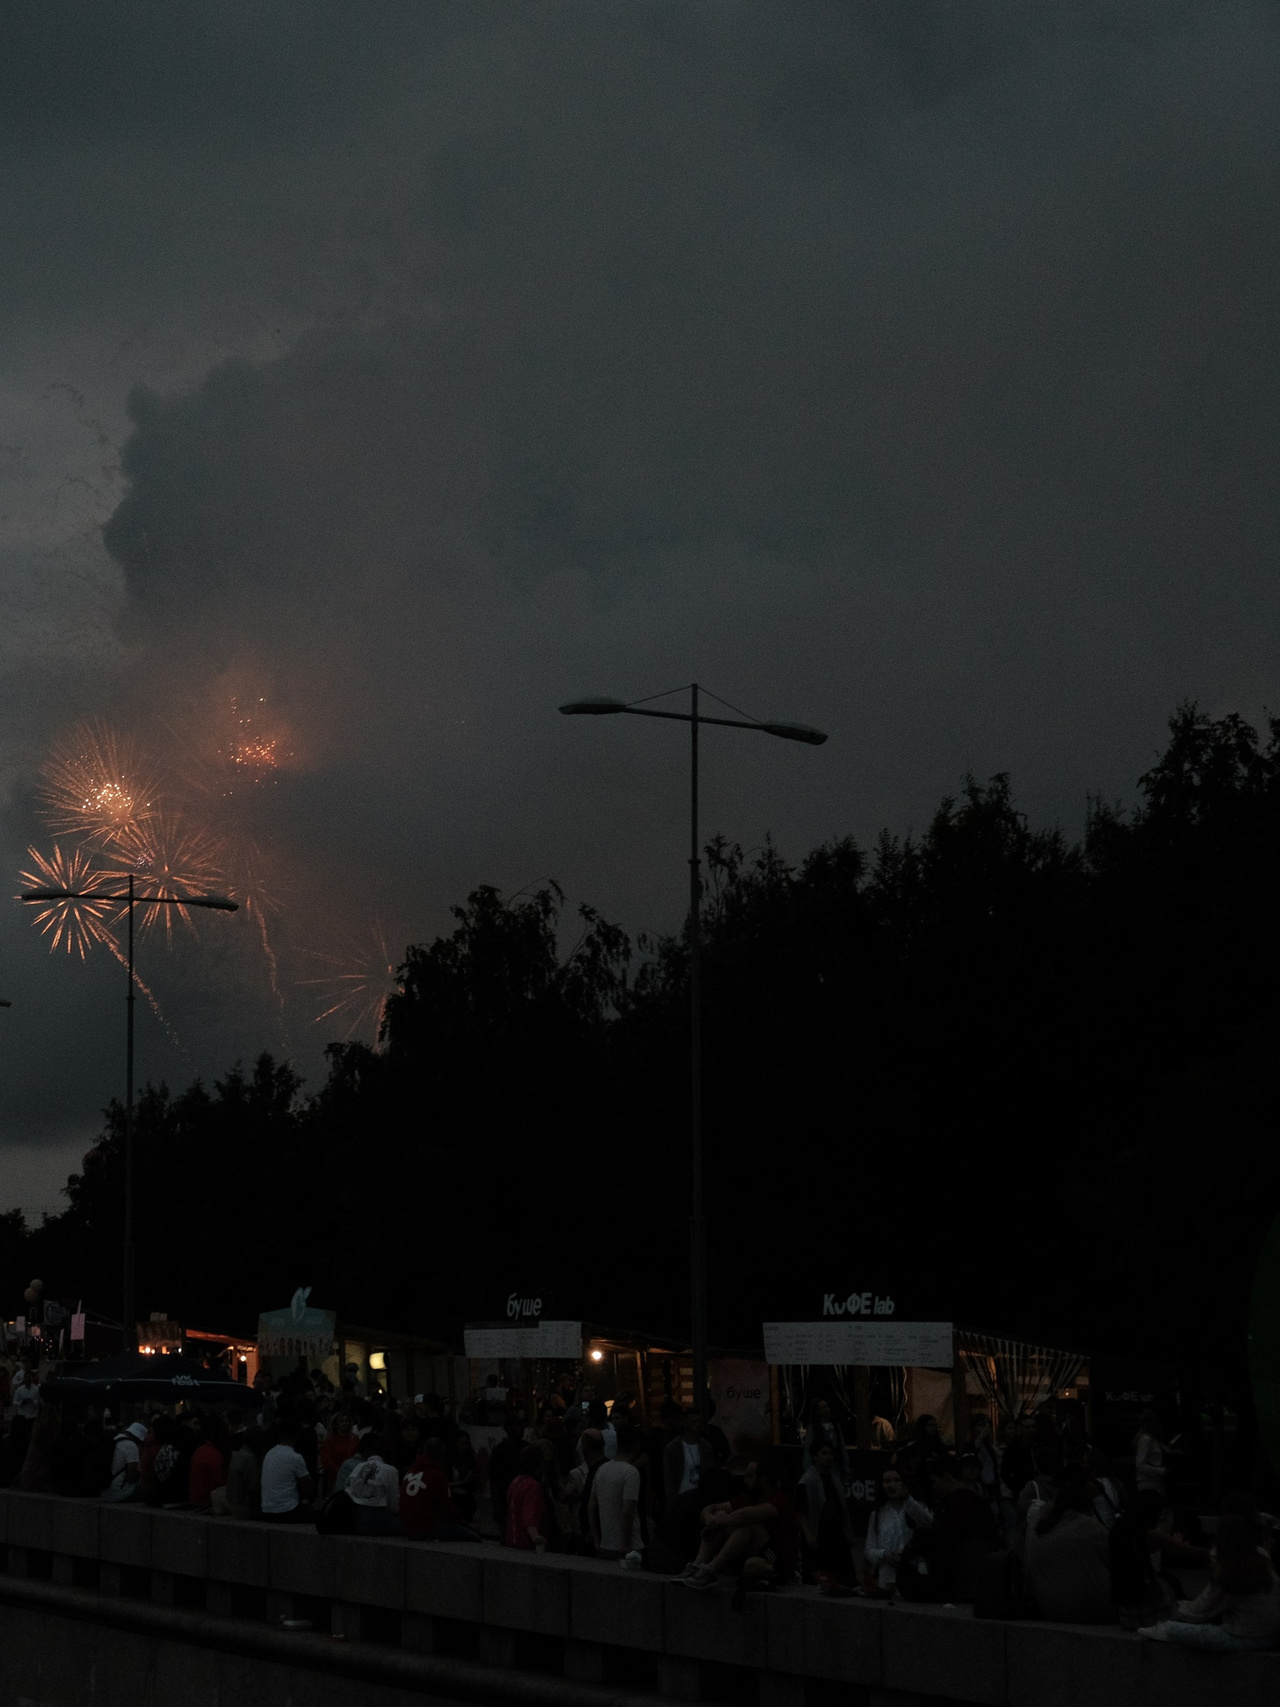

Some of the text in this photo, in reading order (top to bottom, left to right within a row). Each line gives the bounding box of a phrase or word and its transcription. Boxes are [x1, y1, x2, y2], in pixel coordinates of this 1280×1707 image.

[506, 1292, 543, 1320] буше
[873, 1295, 895, 1315] lab
[726, 1385, 761, 1401] буше
